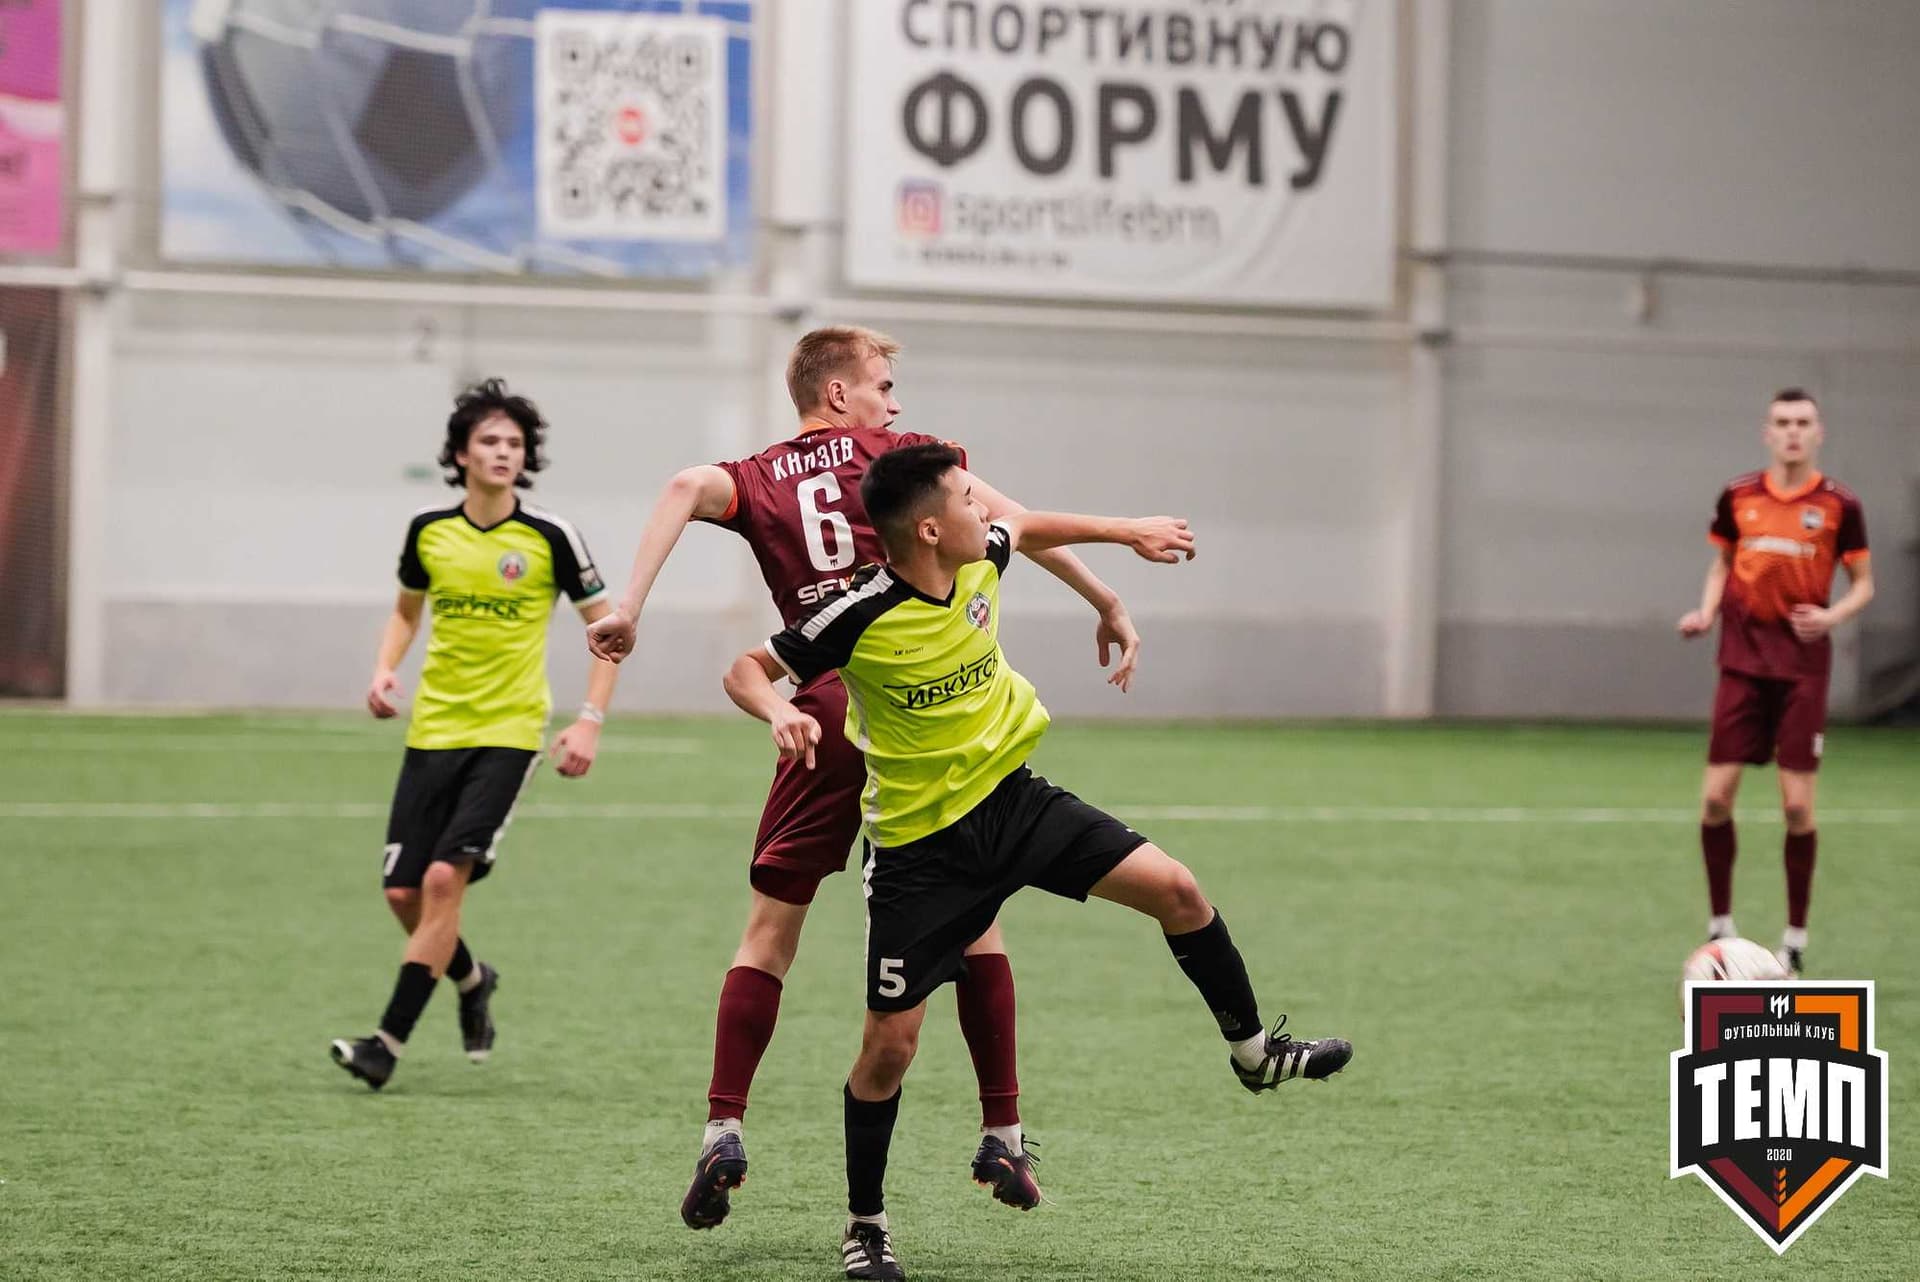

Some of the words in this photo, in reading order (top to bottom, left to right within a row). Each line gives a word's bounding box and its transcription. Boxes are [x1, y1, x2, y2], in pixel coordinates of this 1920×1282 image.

[902, 0, 1350, 73] СПОРТИВНУЮ
[903, 71, 1344, 189] ФОРМУ
[797, 471, 856, 572] 6
[878, 957, 906, 998] 5
